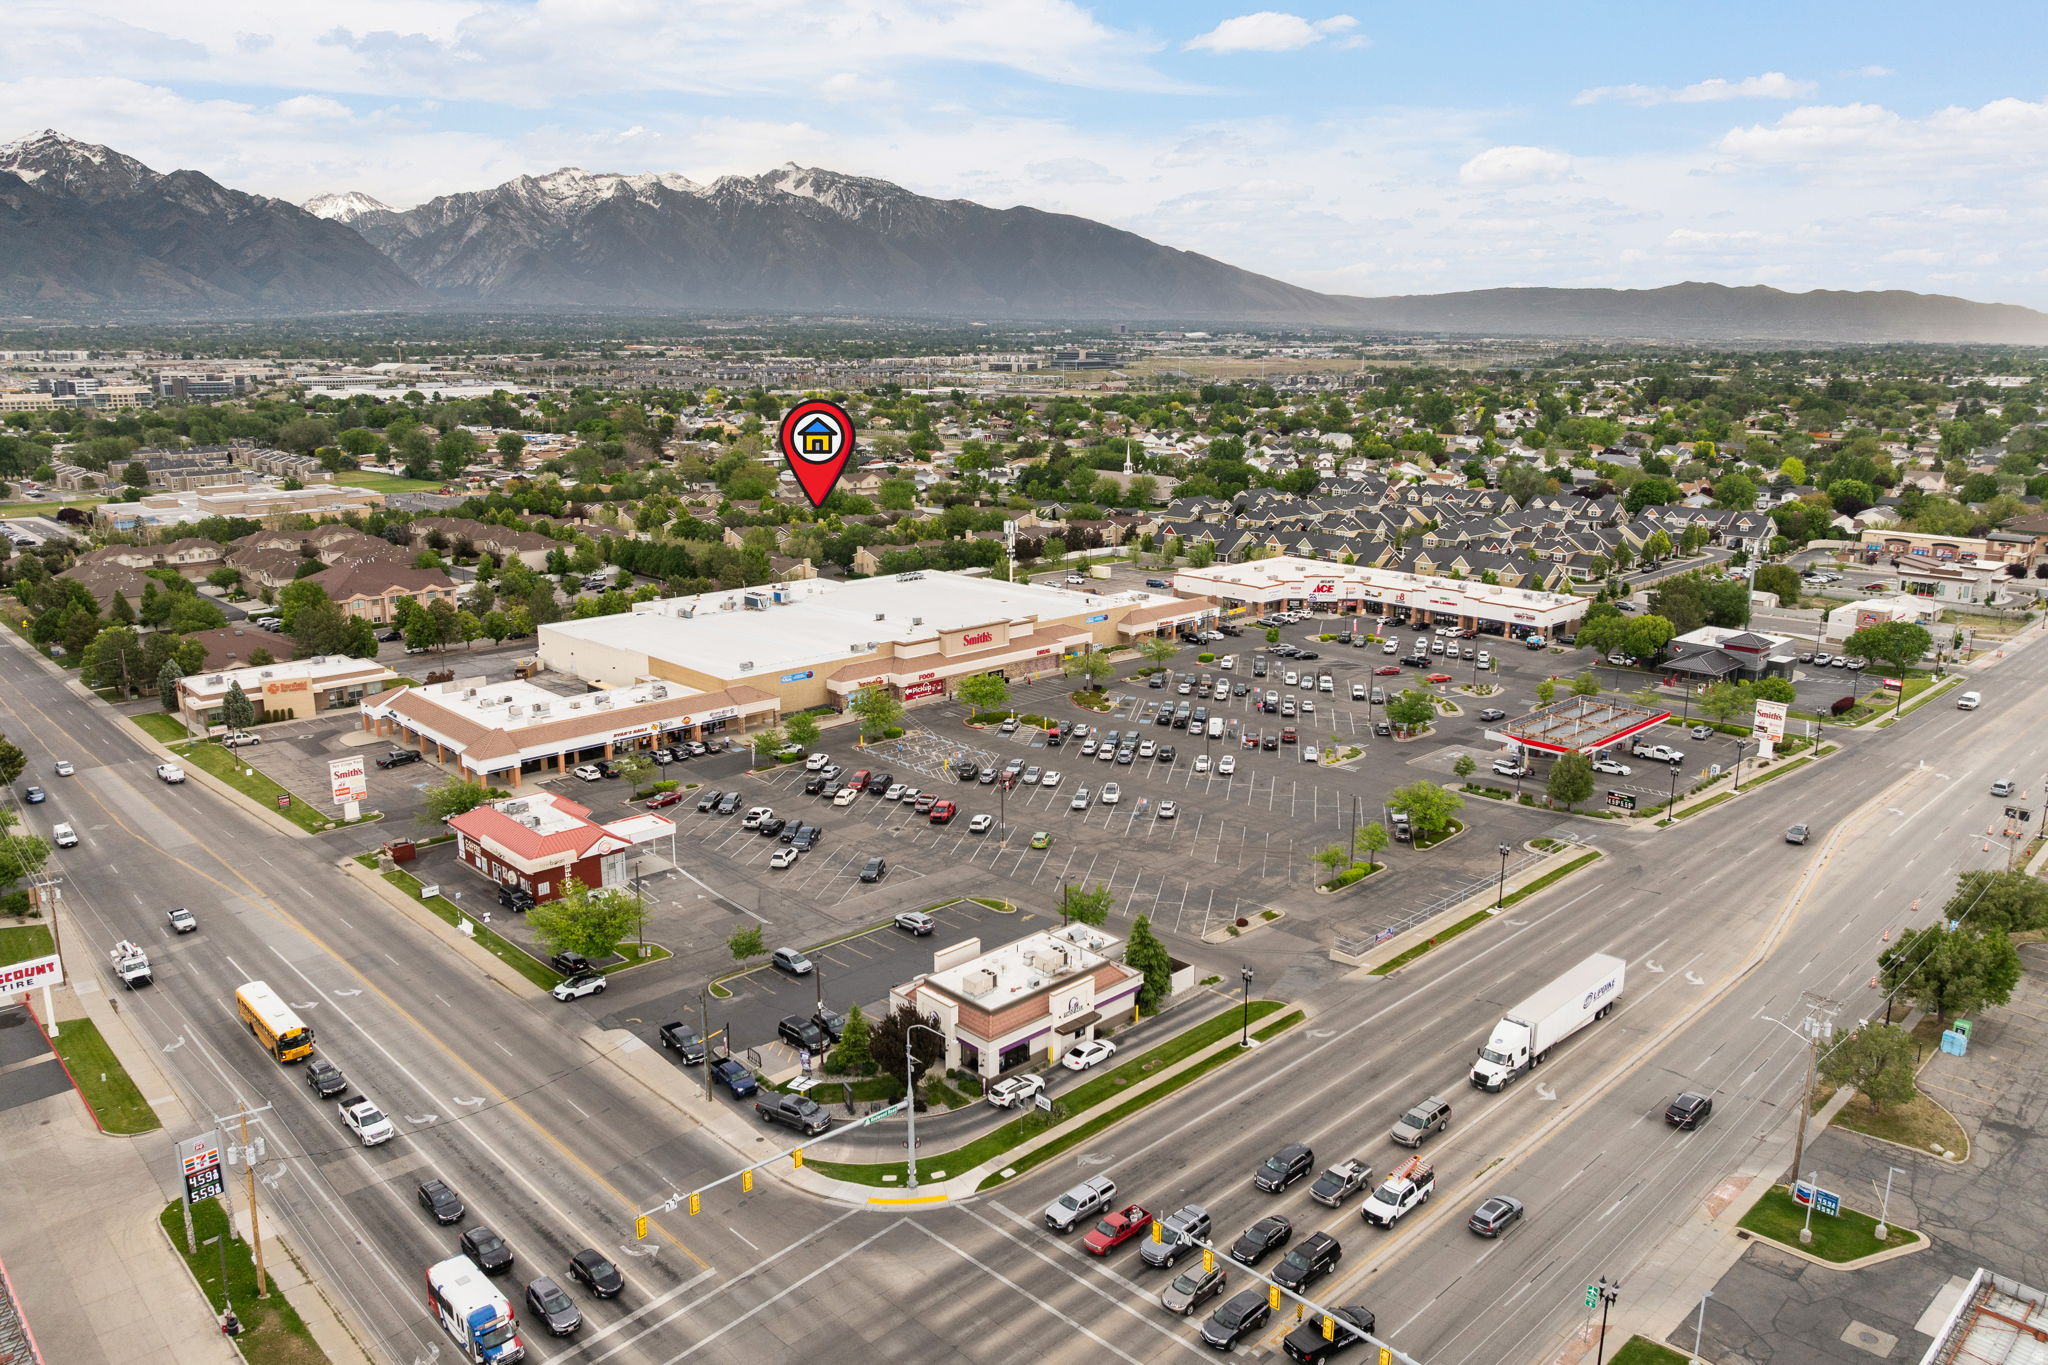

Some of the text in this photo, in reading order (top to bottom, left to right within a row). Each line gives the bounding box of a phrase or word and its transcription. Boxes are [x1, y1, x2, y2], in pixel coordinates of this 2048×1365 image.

[1312, 584, 1335, 593] ACE
[963, 631, 992, 647] Smith's
[1036, 648, 1051, 656] DRUG
[918, 672, 935, 681] FOOD
[1757, 709, 1783, 721] Smith's
[633, 727, 648, 735] NAILS
[334, 768, 364, 780] Smith's
[0, 978, 34, 991] TIRE
